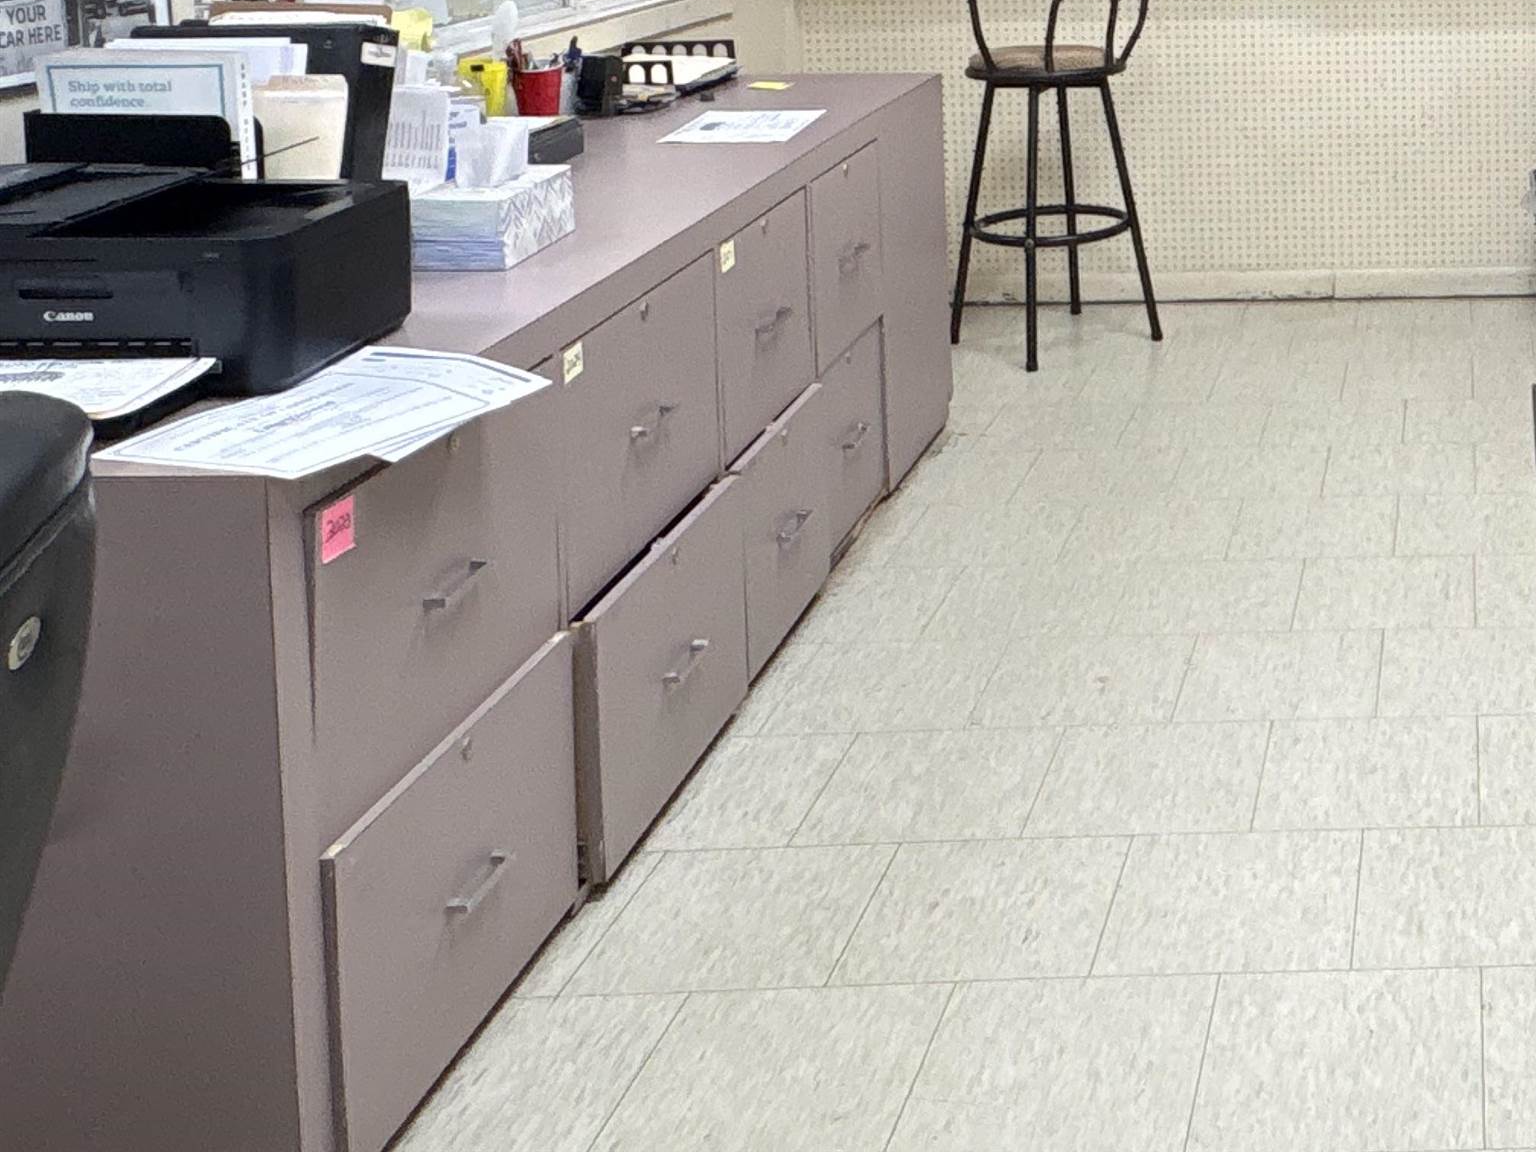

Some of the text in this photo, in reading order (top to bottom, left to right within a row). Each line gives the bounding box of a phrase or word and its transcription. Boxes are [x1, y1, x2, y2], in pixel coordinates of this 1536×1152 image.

[5, 4, 47, 24] YOUR
[28, 24, 63, 45] HERE
[67, 79, 173, 94] Ship with total
[43, 310, 94, 322] Canon
